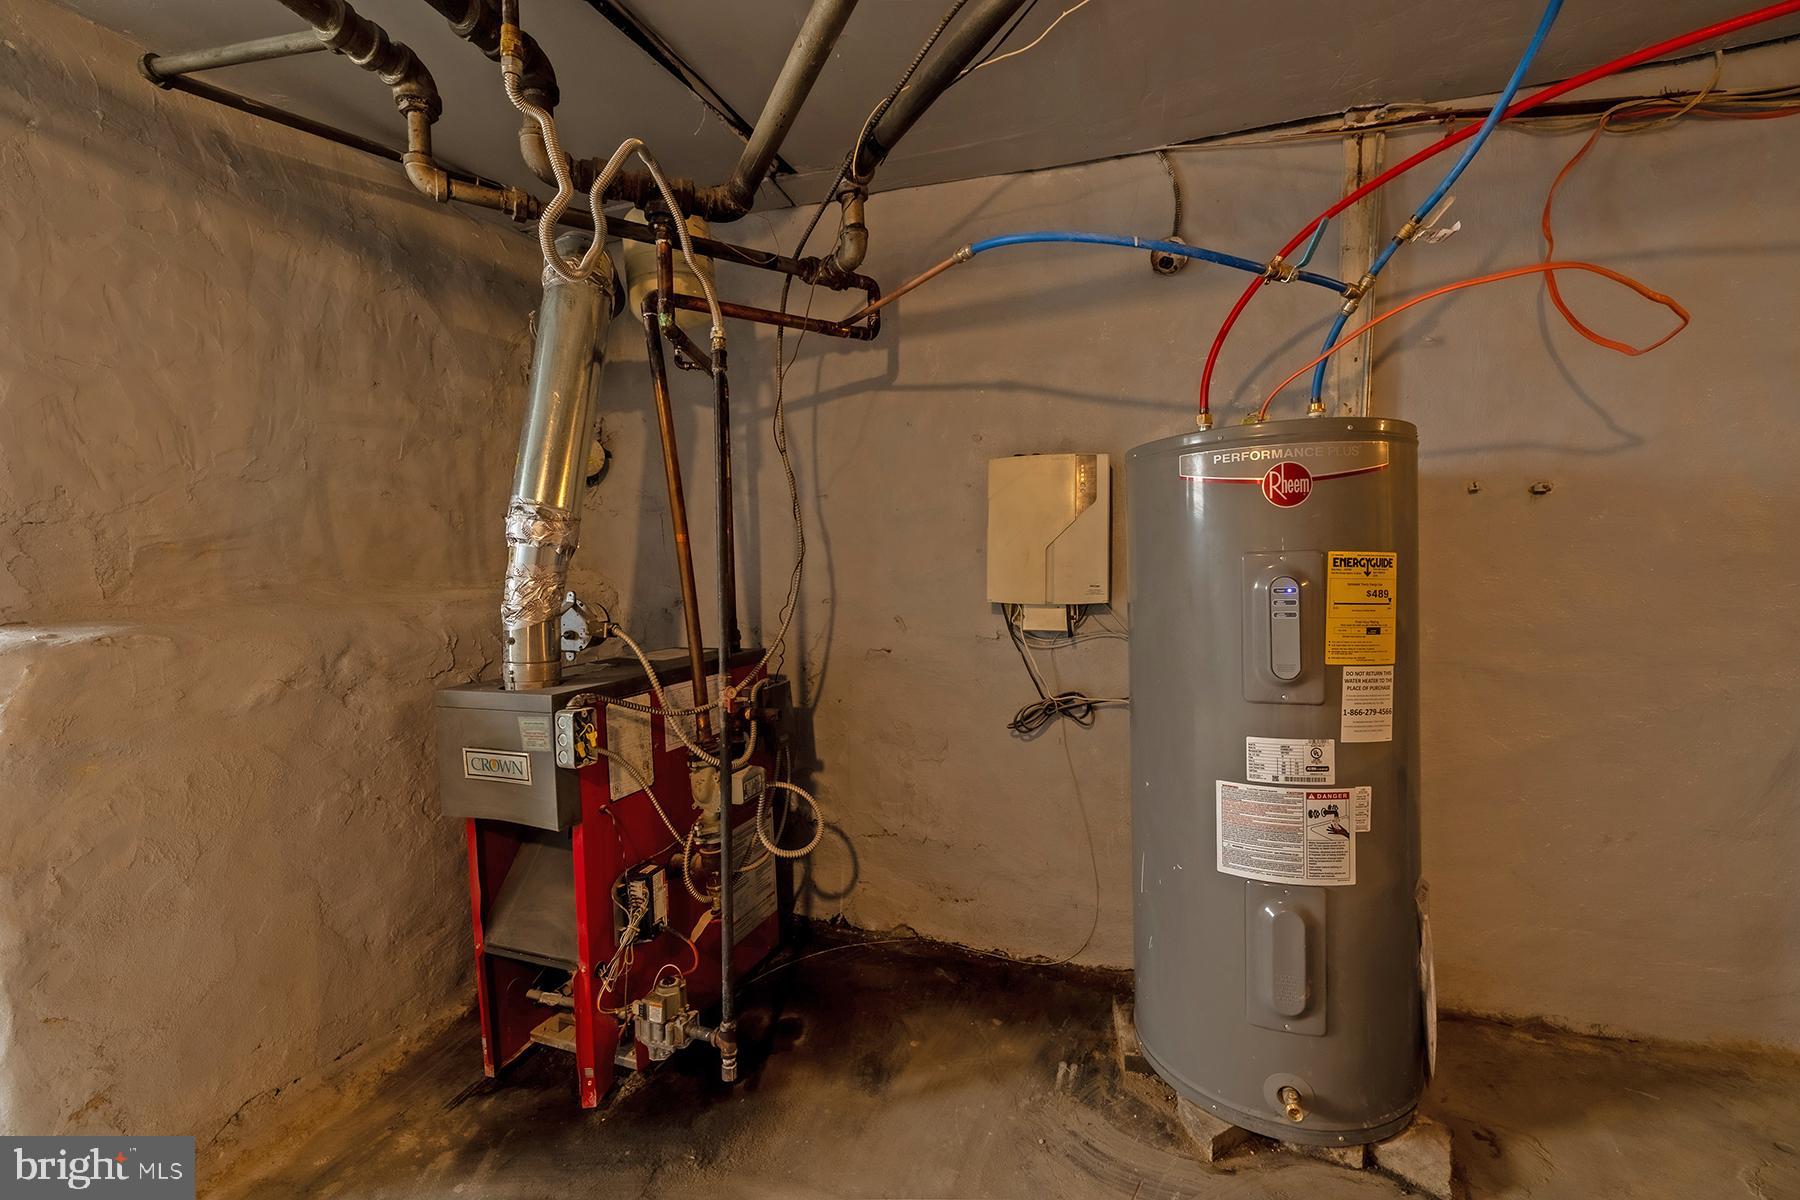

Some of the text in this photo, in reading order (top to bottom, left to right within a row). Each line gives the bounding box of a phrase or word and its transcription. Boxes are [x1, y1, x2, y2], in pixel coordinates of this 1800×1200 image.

[1213, 445, 1360, 464] PERFORMANCE PLUS
[1269, 462, 1310, 500] Rheem
[1366, 589, 1389, 598] $489
[1343, 708, 1392, 716] 1-866-279-4566
[471, 757, 523, 775] CROWN
